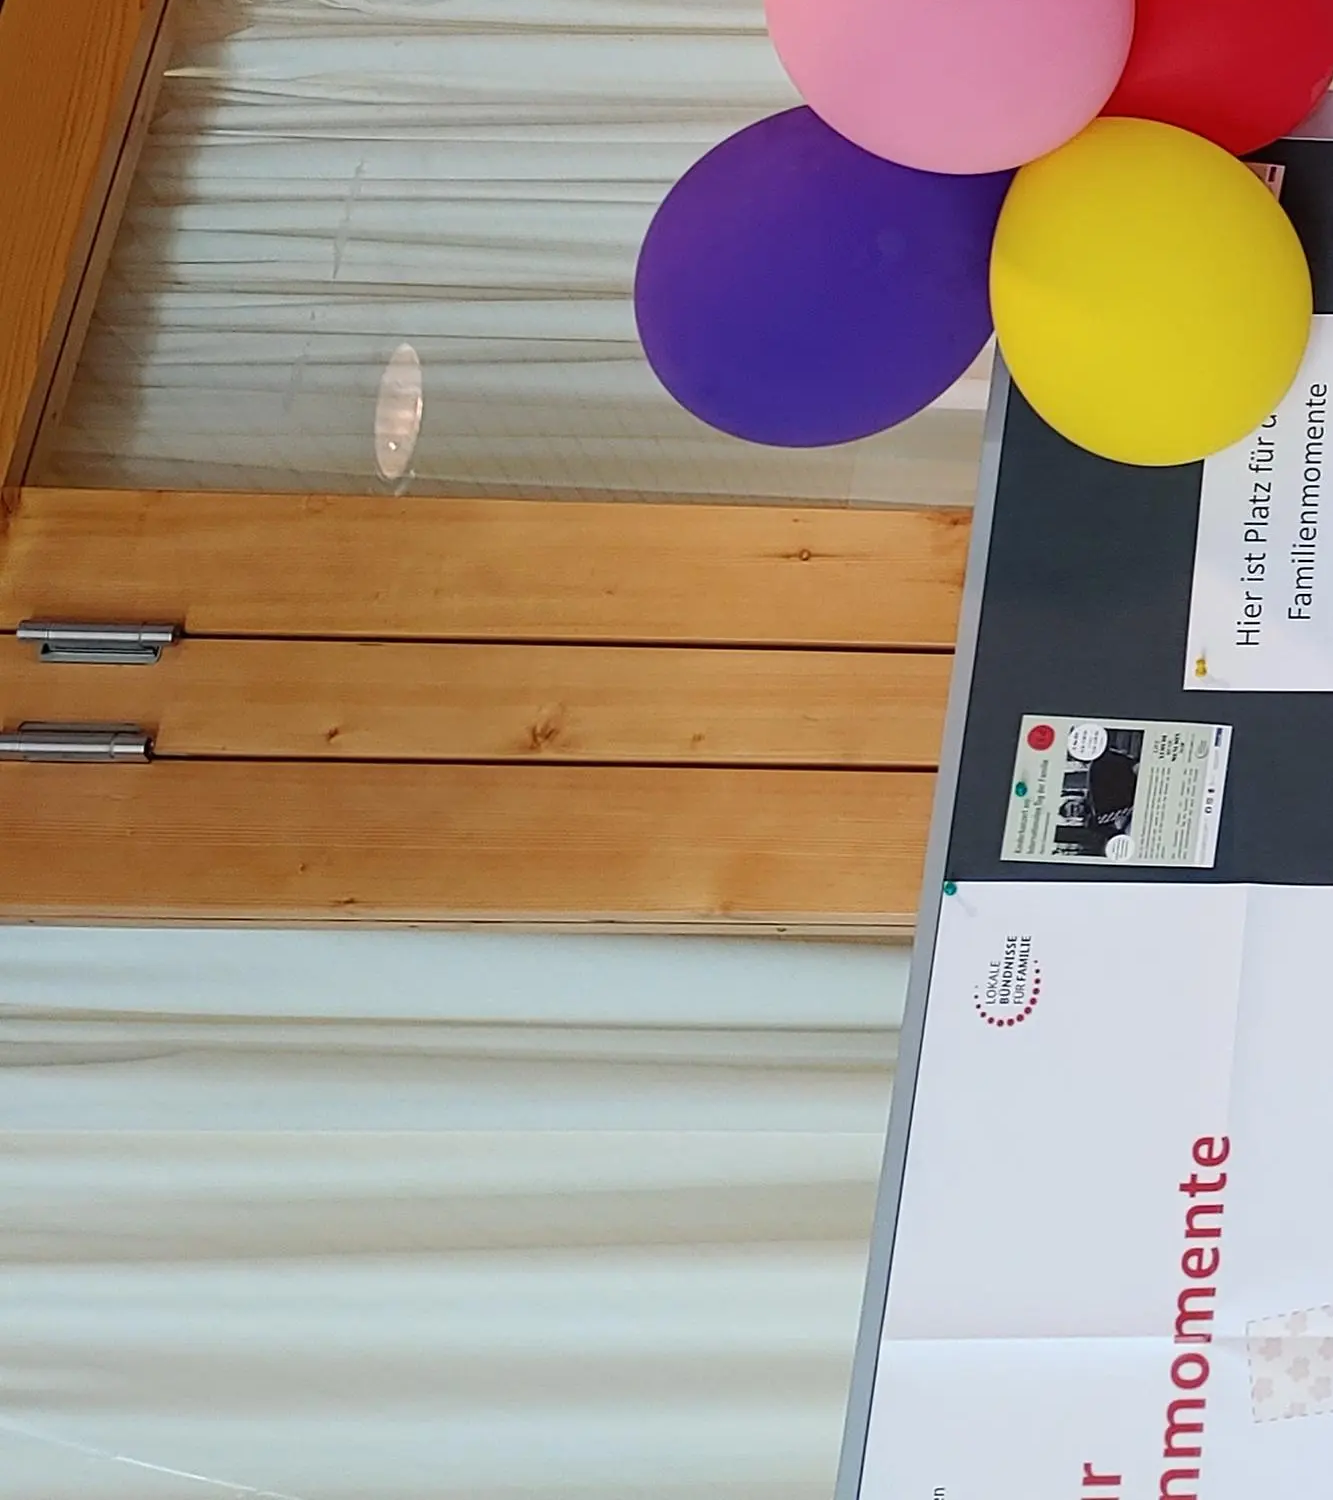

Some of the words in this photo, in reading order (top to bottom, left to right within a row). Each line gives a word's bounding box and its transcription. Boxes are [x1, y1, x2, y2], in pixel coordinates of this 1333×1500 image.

[1249, 436, 1275, 473] für
[1244, 482, 1272, 543] Platz
[1288, 382, 1328, 620] Familienmomente
[1240, 552, 1267, 583] ist
[1235, 591, 1263, 646] Hier
[997, 935, 1018, 1005] BÜNDNISSE
[1015, 935, 1032, 982] FAMILIE
[985, 961, 1000, 1005] LOKALE
[1012, 983, 1027, 1005] FÜR
